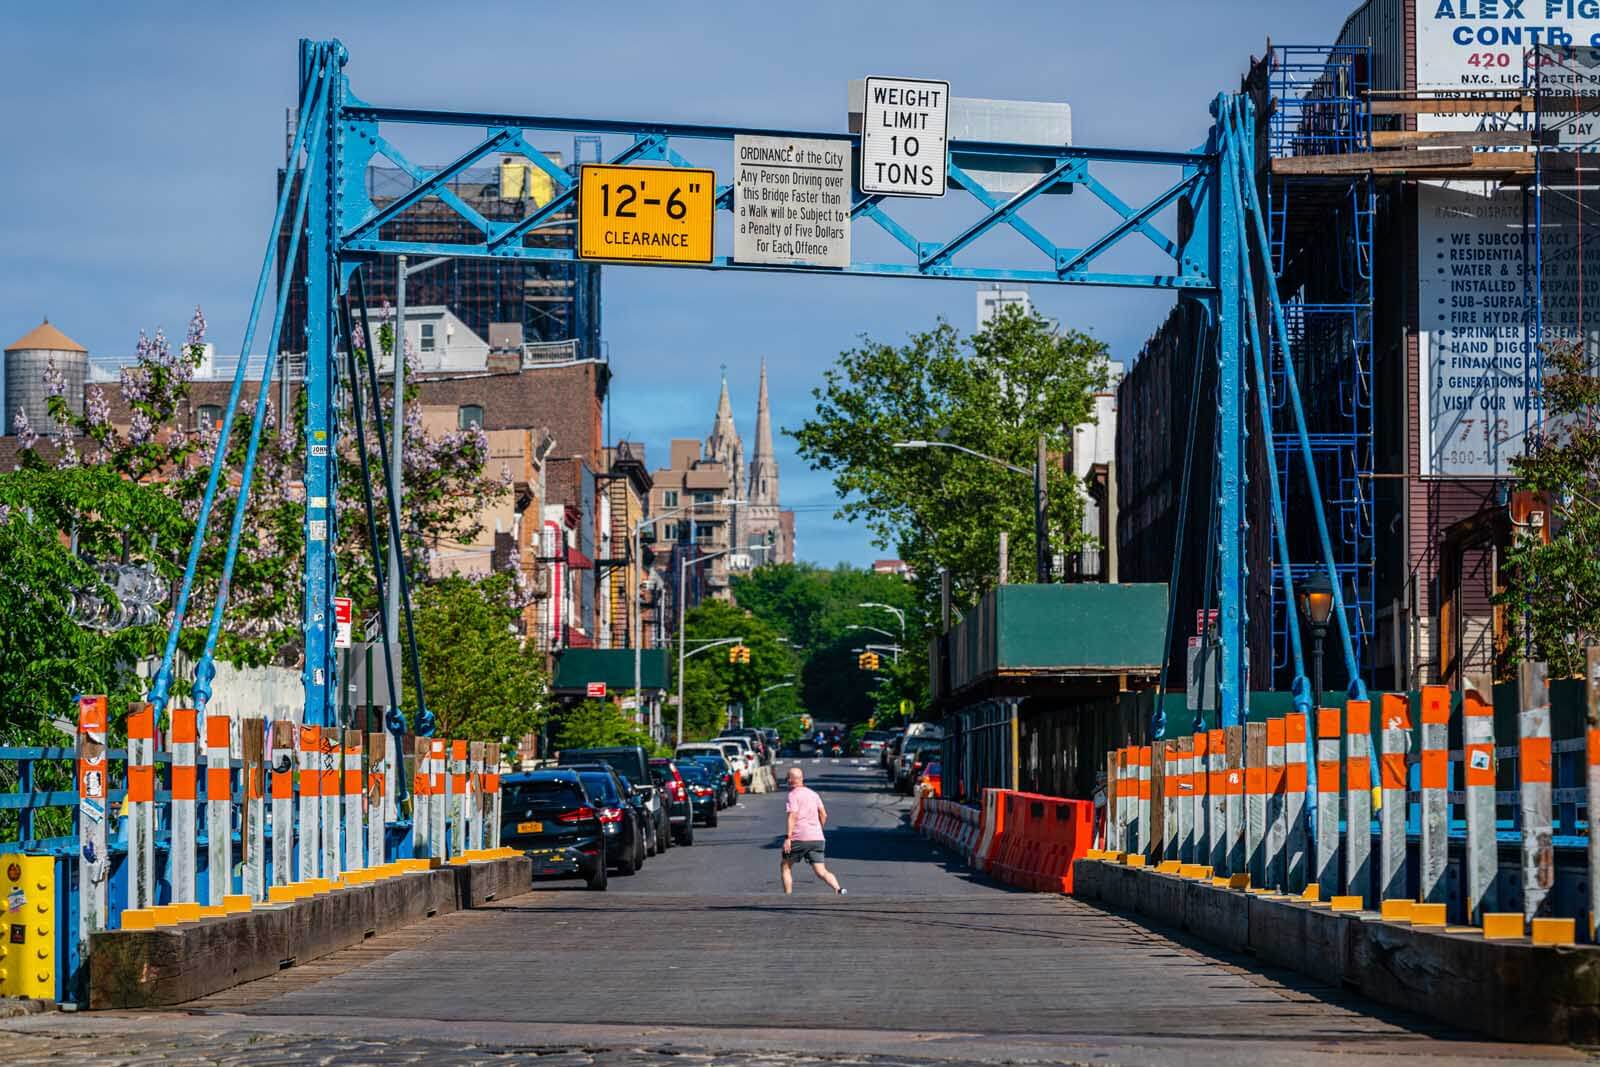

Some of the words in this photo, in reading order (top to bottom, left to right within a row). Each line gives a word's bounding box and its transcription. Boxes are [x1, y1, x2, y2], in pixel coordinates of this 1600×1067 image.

[1434, 0, 1526, 19] ALEX
[1467, 53, 1510, 68] 420
[1461, 74, 1494, 84] N.Y.C.
[874, 87, 941, 108] WEIGHT
[882, 110, 929, 130] LIMIT
[1568, 124, 1593, 135] DAY
[890, 135, 920, 157] 10
[740, 146, 793, 162] ORDINANCE
[795, 150, 804, 163] of
[807, 151, 822, 164] the
[824, 151, 843, 168] City
[740, 169, 758, 185] Any
[760, 170, 790, 184] Person
[792, 172, 822, 189] Driving
[825, 177, 843, 187] over
[874, 162, 934, 186] TONS
[743, 187, 759, 201] this
[762, 187, 789, 205] Bridge
[792, 189, 818, 203] Faster
[821, 191, 841, 205] than
[740, 206, 746, 216] a
[748, 204, 768, 218] Walk
[770, 206, 785, 219] will
[787, 207, 798, 220] be
[800, 207, 832, 224] Subject
[835, 210, 844, 222] to
[740, 224, 746, 234] a
[748, 222, 781, 237] Penalty
[784, 223, 792, 236] of
[795, 224, 813, 237] Five
[815, 225, 844, 239] Dollars
[604, 231, 689, 247] CLEARANCE
[1451, 233, 1471, 246] WE
[757, 239, 770, 252] For
[772, 239, 793, 254] Each
[795, 240, 828, 256] Offence
[1450, 249, 1528, 261] RESIDENTIA
[1451, 264, 1492, 276] WATER
[1500, 264, 1508, 276] &
[1451, 280, 1516, 292] INSTALLED
[1451, 311, 1477, 323] FIRE
[1451, 327, 1519, 339] SPRINKLER
[1451, 342, 1489, 353] HAND
[1451, 357, 1522, 369] FINANCING
[1449, 377, 1523, 389] GENERATIONS
[1442, 396, 1474, 410] VISIT
[1480, 396, 1506, 410] OUR
